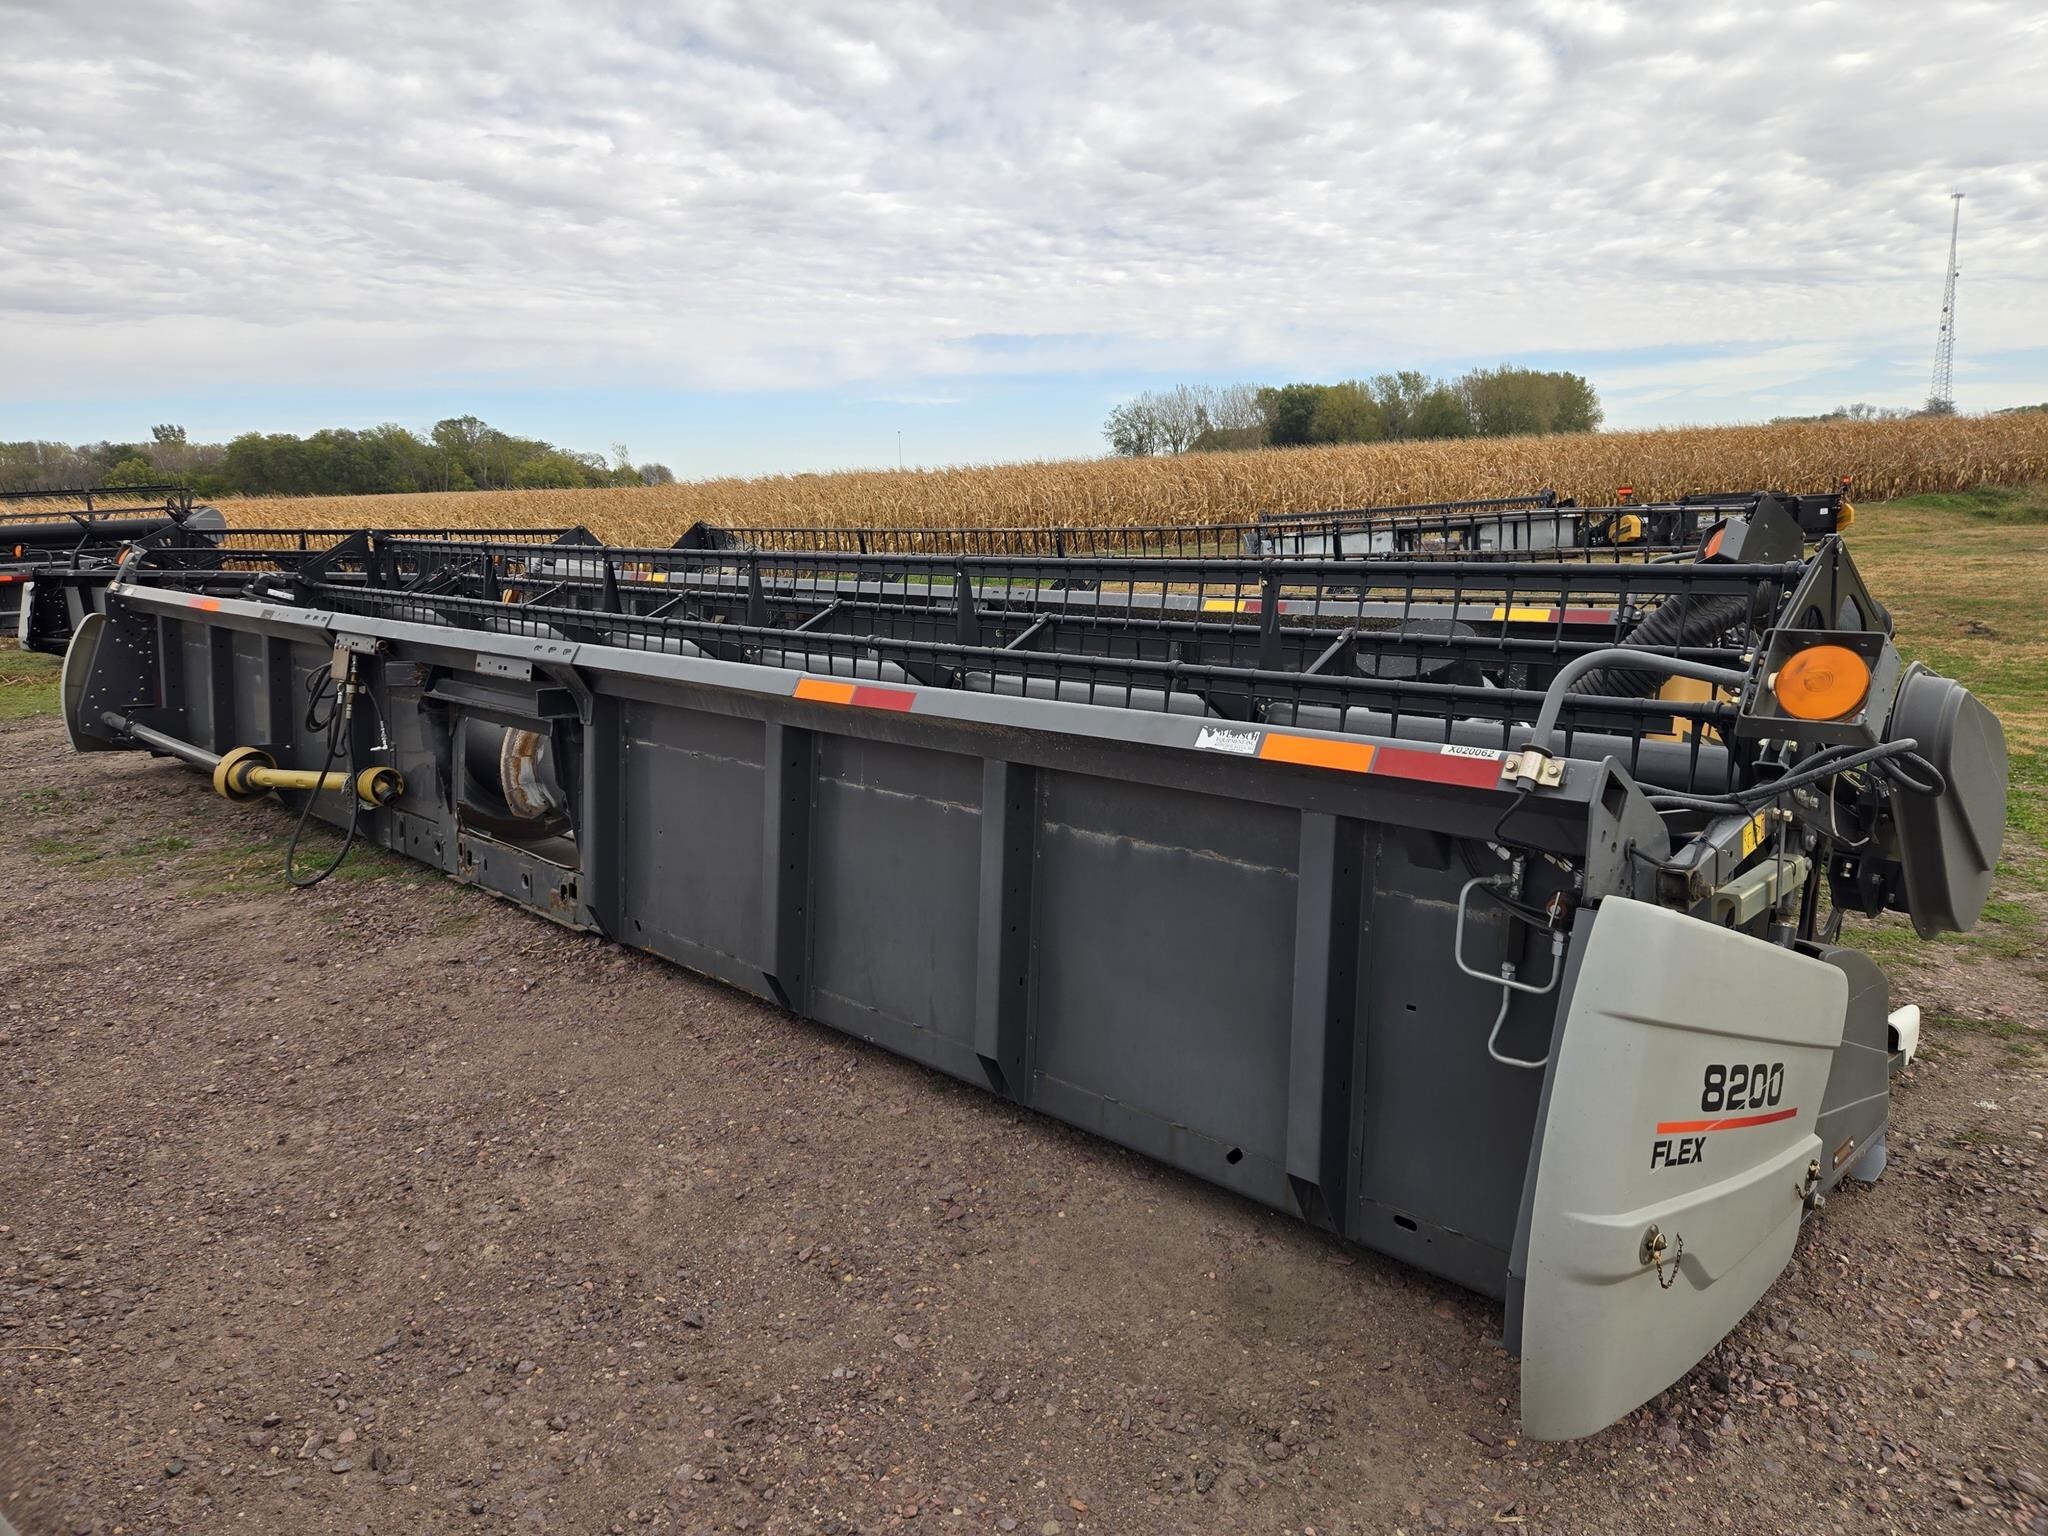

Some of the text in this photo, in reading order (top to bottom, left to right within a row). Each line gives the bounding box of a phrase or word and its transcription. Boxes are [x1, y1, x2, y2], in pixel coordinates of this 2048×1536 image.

[1448, 746, 1495, 757] X020062
[1701, 1062, 1785, 1112] 8200
[1650, 1136, 1706, 1169] FLEX
